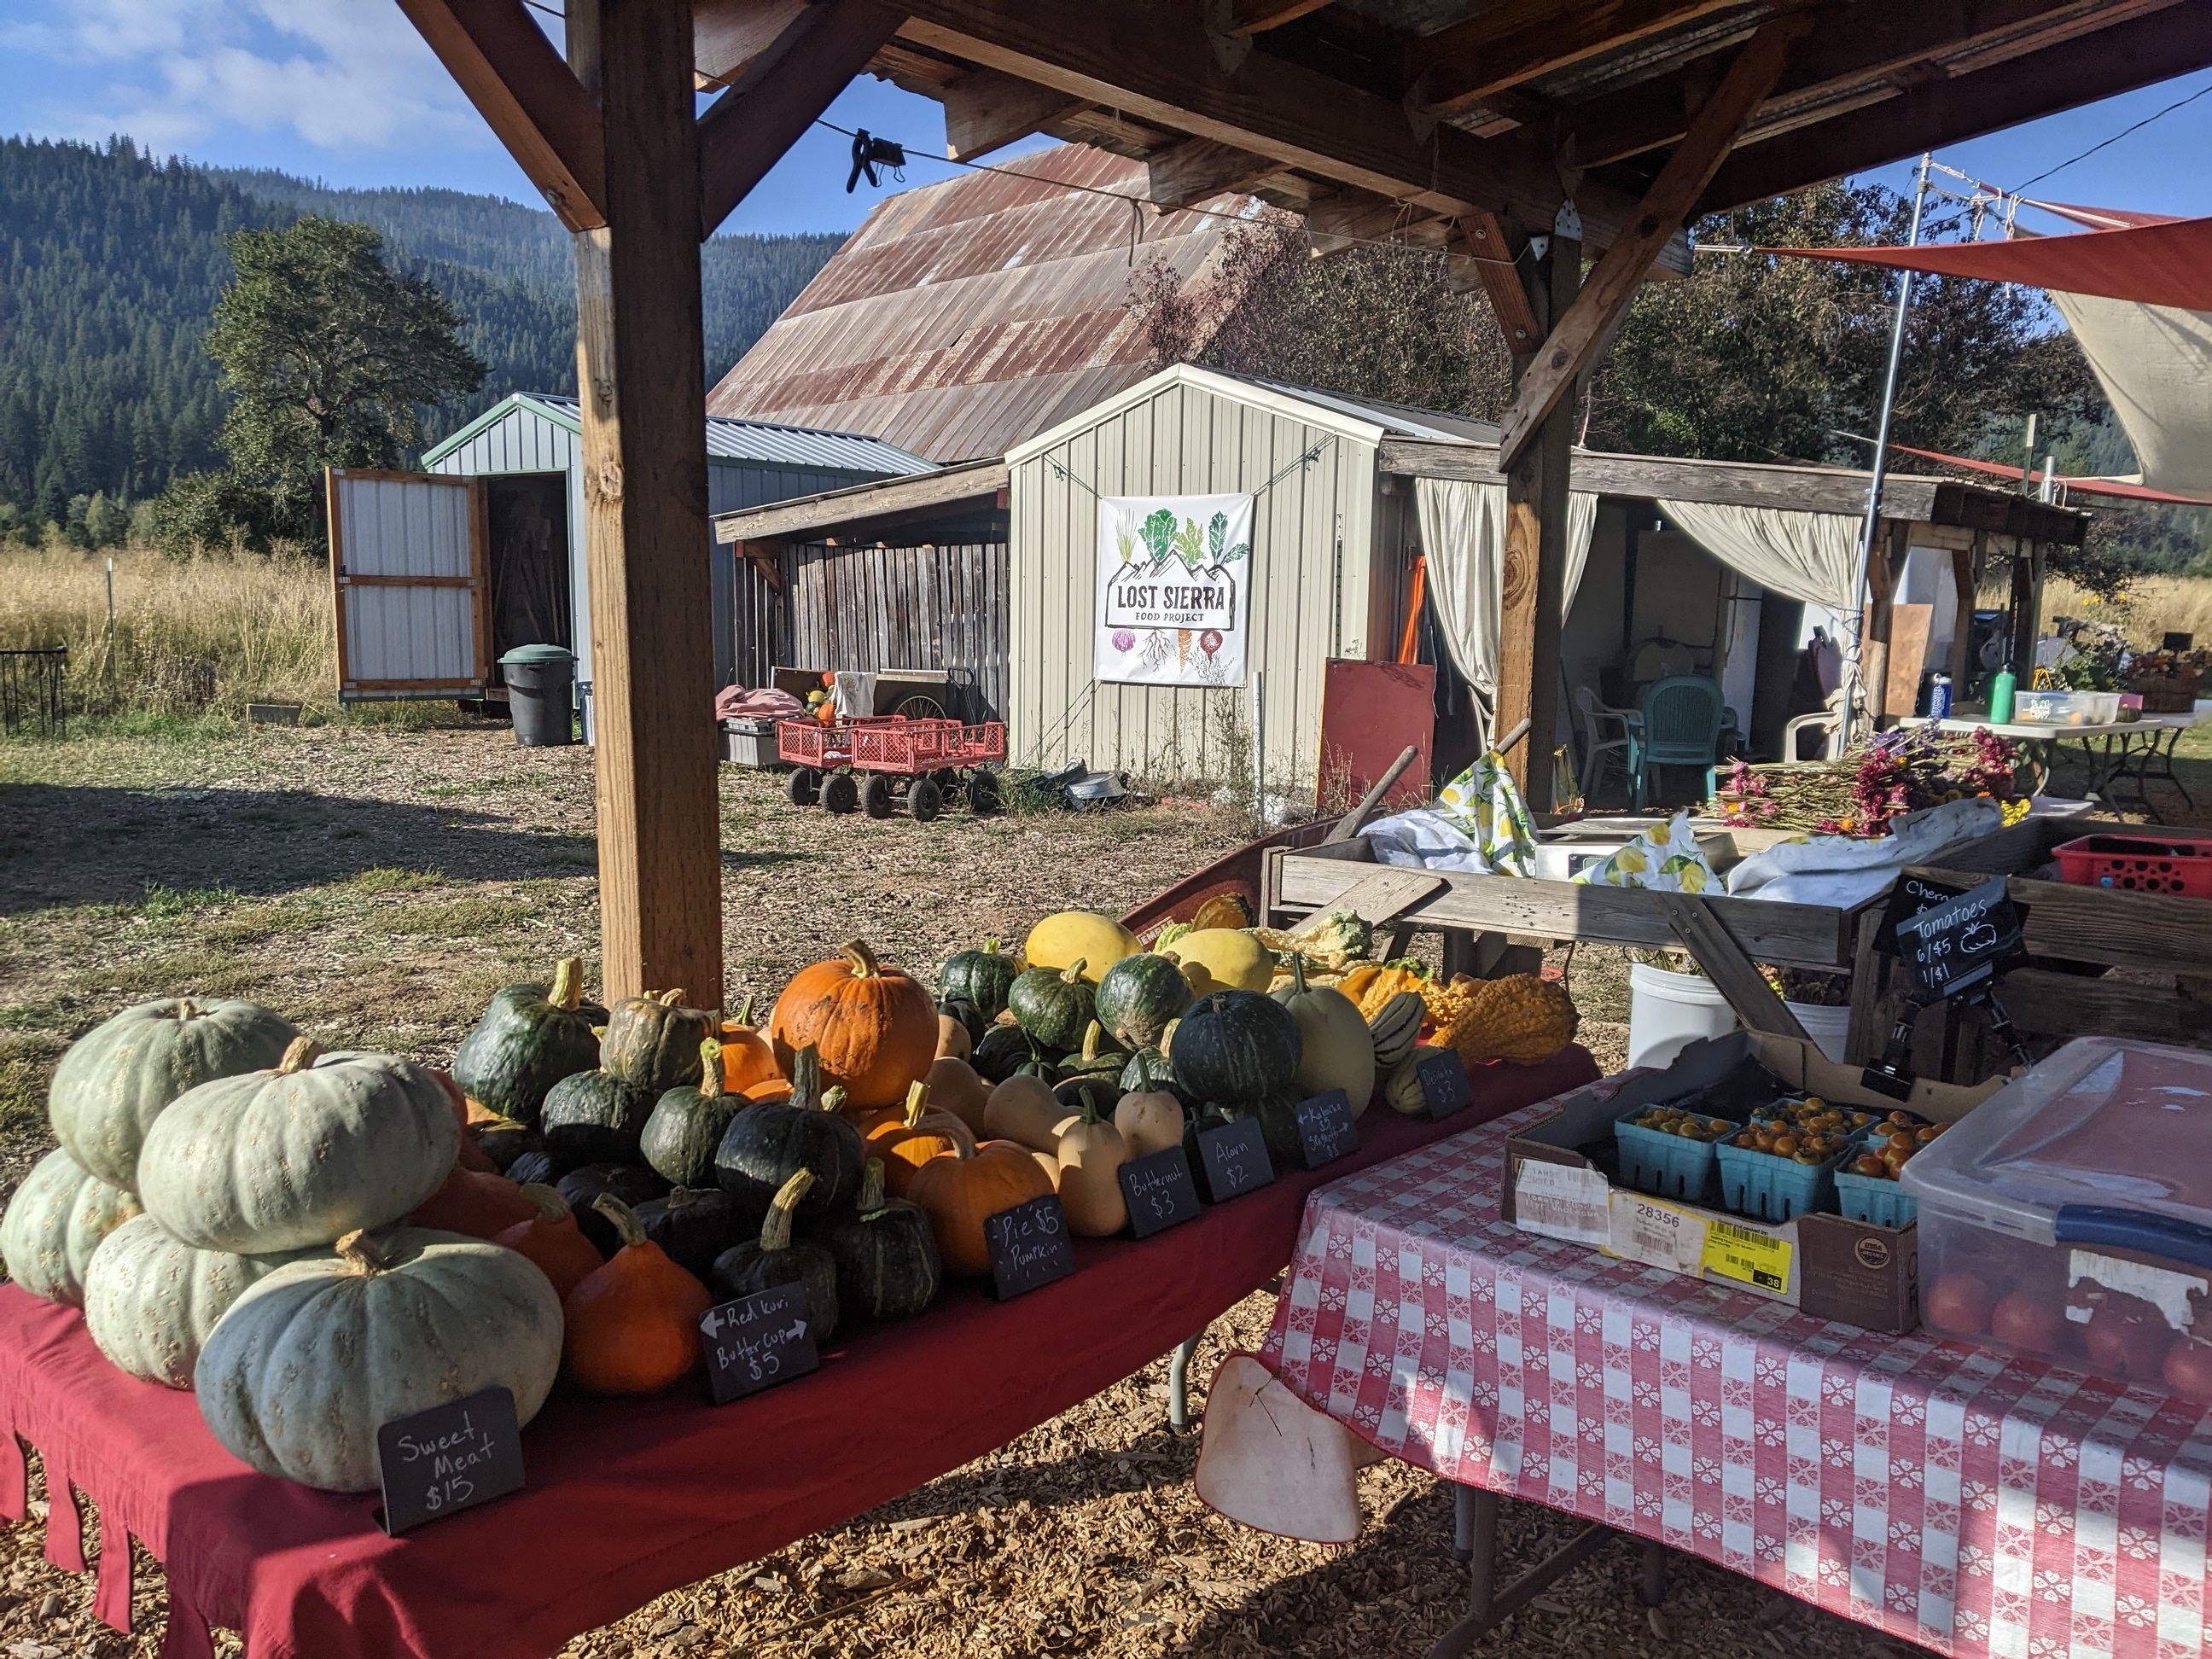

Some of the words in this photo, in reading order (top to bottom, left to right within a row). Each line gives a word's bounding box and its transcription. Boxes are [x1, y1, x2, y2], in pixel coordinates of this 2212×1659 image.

[1117, 585, 1158, 608] LOST
[1163, 585, 1225, 610] SIERRA
[1135, 612, 1161, 621] FOOD
[1163, 612, 1204, 623] PROJECT
[1913, 899, 1987, 938] Tomatoes
[1917, 937, 1951, 963] 6/$5
[1923, 963, 1951, 989] 1/$1
[1216, 1141, 1249, 1164] Acorn
[1128, 1163, 1184, 1196] Butternut
[1226, 1165, 1249, 1189] $2
[1150, 1190, 1175, 1219] $3
[1637, 1203, 1680, 1228] 28356
[1003, 1216, 1033, 1248] Pie
[1035, 1207, 1059, 1235] $5
[1767, 1277, 1779, 1288] 38
[727, 1301, 760, 1328] Red
[398, 1410, 475, 1462] Sweet
[434, 1432, 496, 1479] Meat
[427, 1476, 474, 1511] $15
